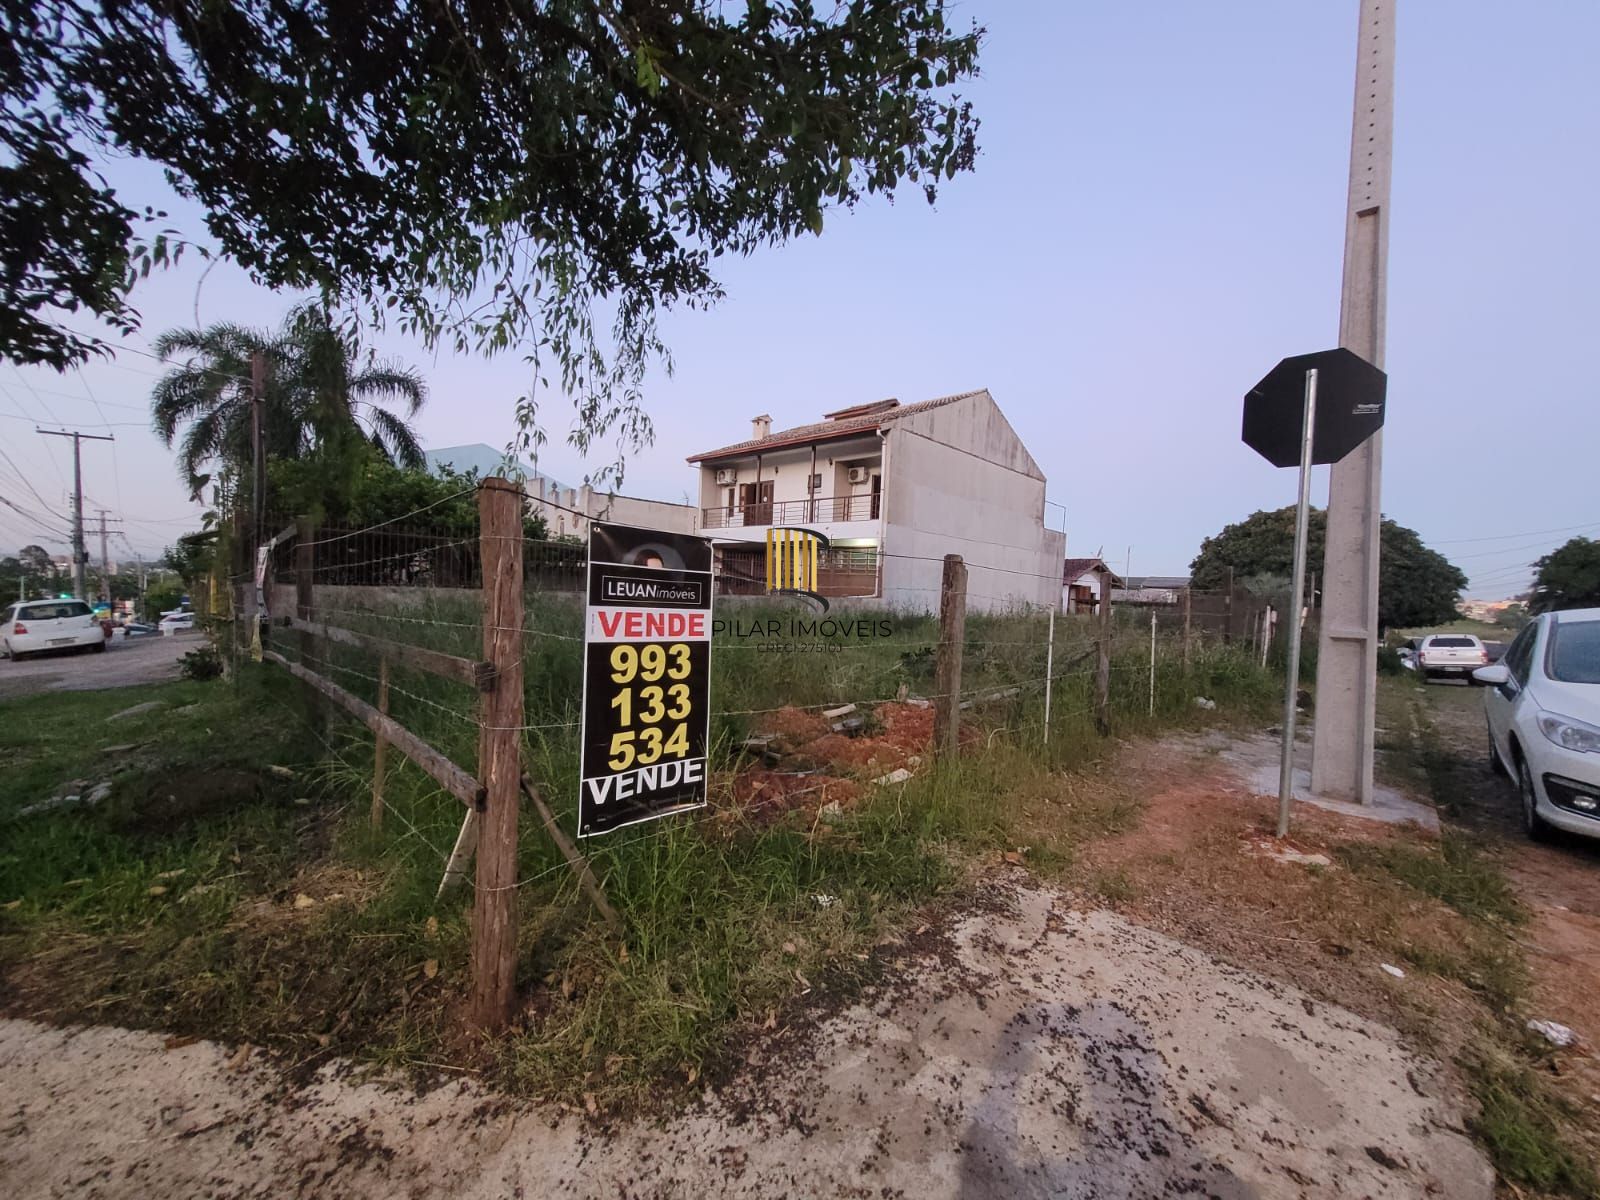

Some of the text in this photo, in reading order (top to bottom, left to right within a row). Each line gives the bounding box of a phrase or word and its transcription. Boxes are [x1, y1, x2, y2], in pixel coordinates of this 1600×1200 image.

[598, 611, 705, 637] VENDE
[610, 644, 691, 684] 993
[611, 684, 691, 727] 133
[608, 722, 690, 771] 534
[587, 759, 703, 805] VENDE
